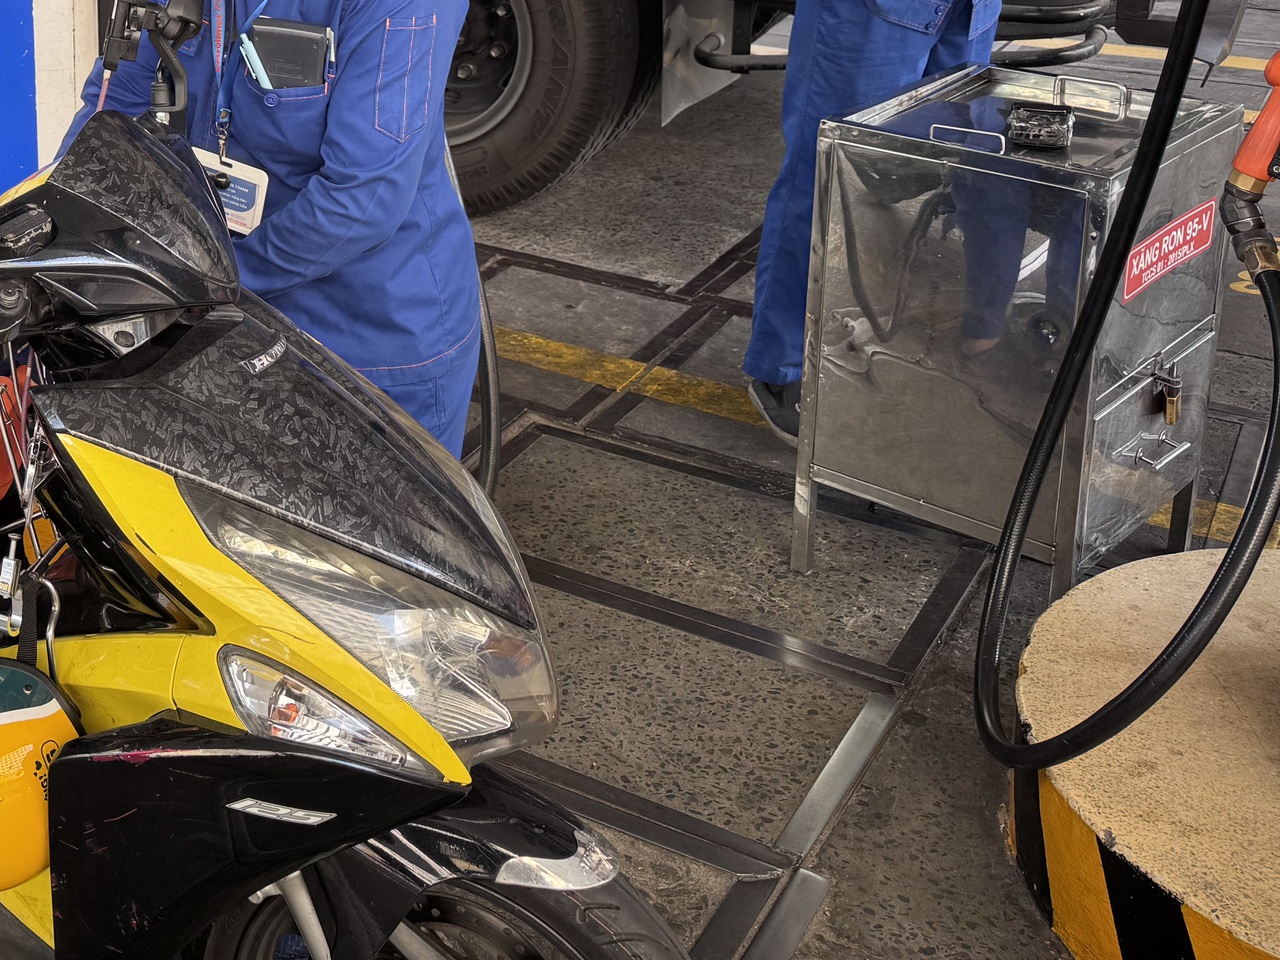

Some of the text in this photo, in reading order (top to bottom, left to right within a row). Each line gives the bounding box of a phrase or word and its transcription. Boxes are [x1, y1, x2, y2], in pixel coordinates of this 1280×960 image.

[1130, 211, 1210, 279] XĂNG RON 95-V
[1141, 265, 1156, 283] TCCS
[227, 797, 337, 826] 125
